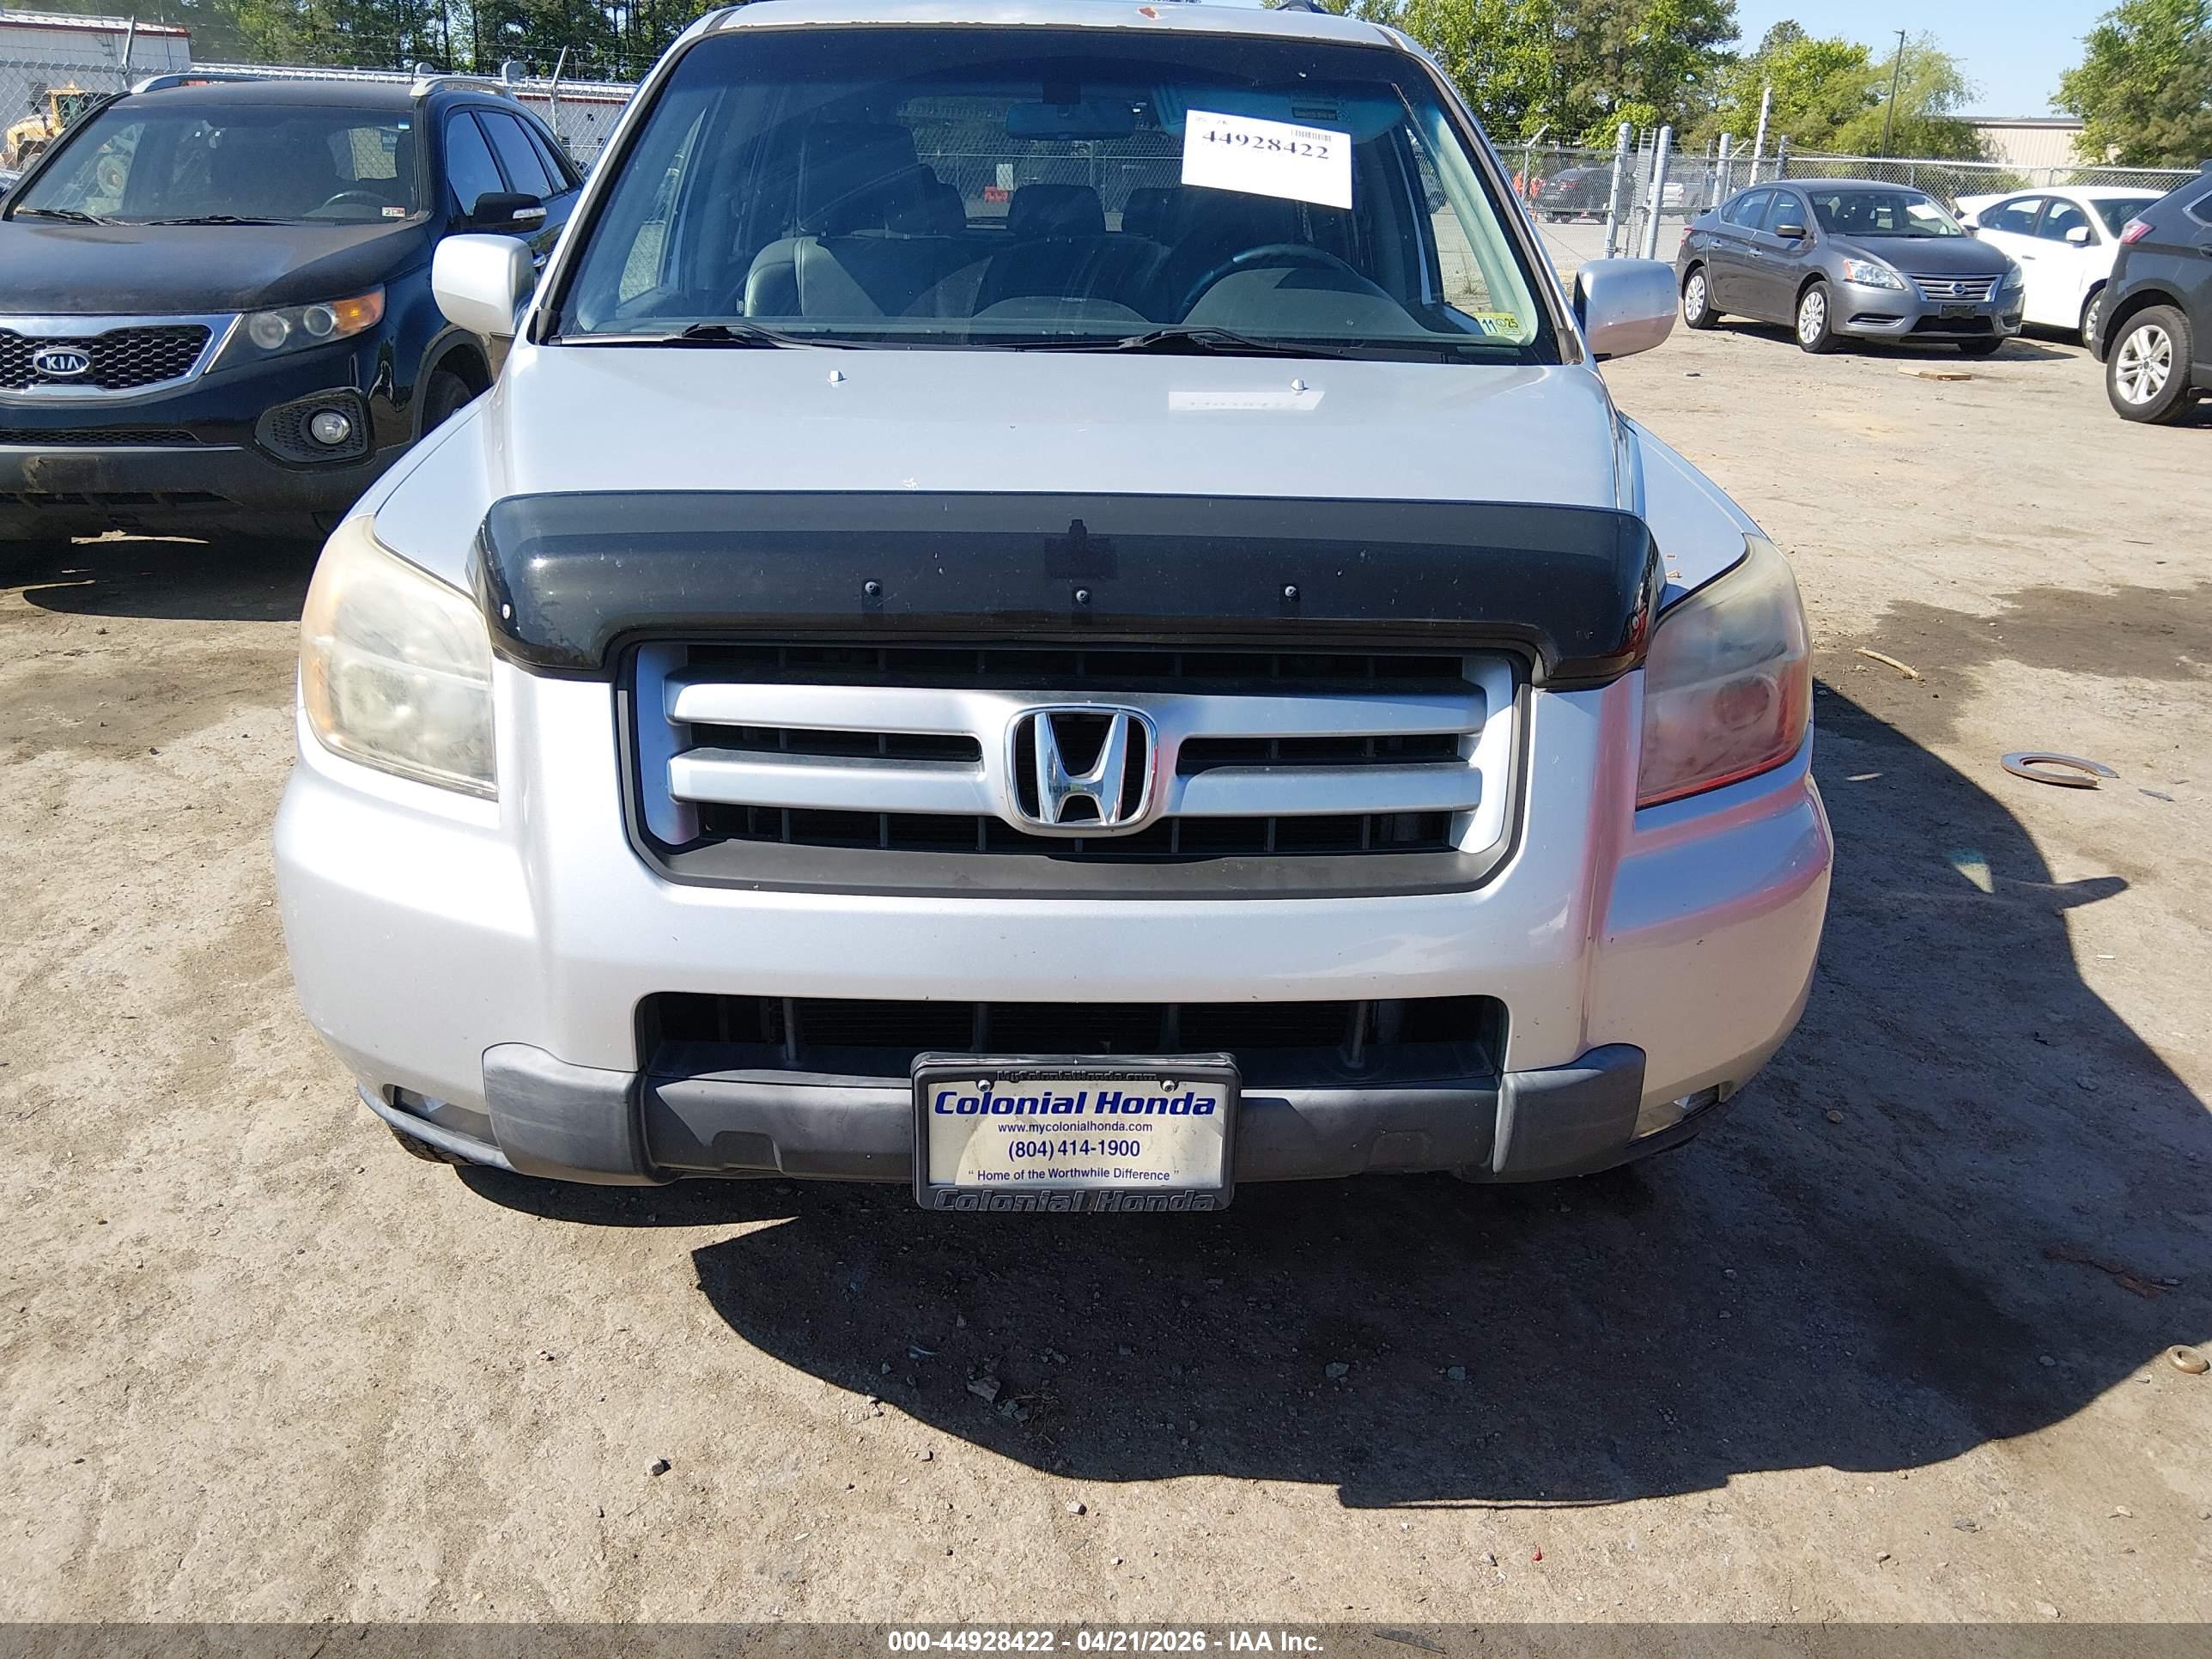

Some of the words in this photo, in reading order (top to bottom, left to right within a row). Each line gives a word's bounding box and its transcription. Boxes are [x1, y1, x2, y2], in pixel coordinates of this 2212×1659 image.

[1202, 130, 1330, 160] 44928422
[1481, 319, 1498, 332] 11
[1504, 318, 1519, 329] 25
[46, 356, 80, 369] KIA
[934, 1091, 1087, 1115] Colonial
[1094, 1091, 1217, 1115] Honda
[998, 1121, 1153, 1134] www.mycolonialhonda.com
[1008, 1139, 1054, 1161] (804)
[1058, 1139, 1141, 1157] 414-1900
[977, 1169, 1012, 1182] Home
[1013, 1169, 1025, 1180] of
[1028, 1169, 1046, 1180] the
[1048, 1167, 1110, 1180] Worthwhile
[1113, 1168, 1170, 1181] Difference
[933, 1189, 1086, 1212] Colonial
[1095, 1190, 1216, 1212] Honda
